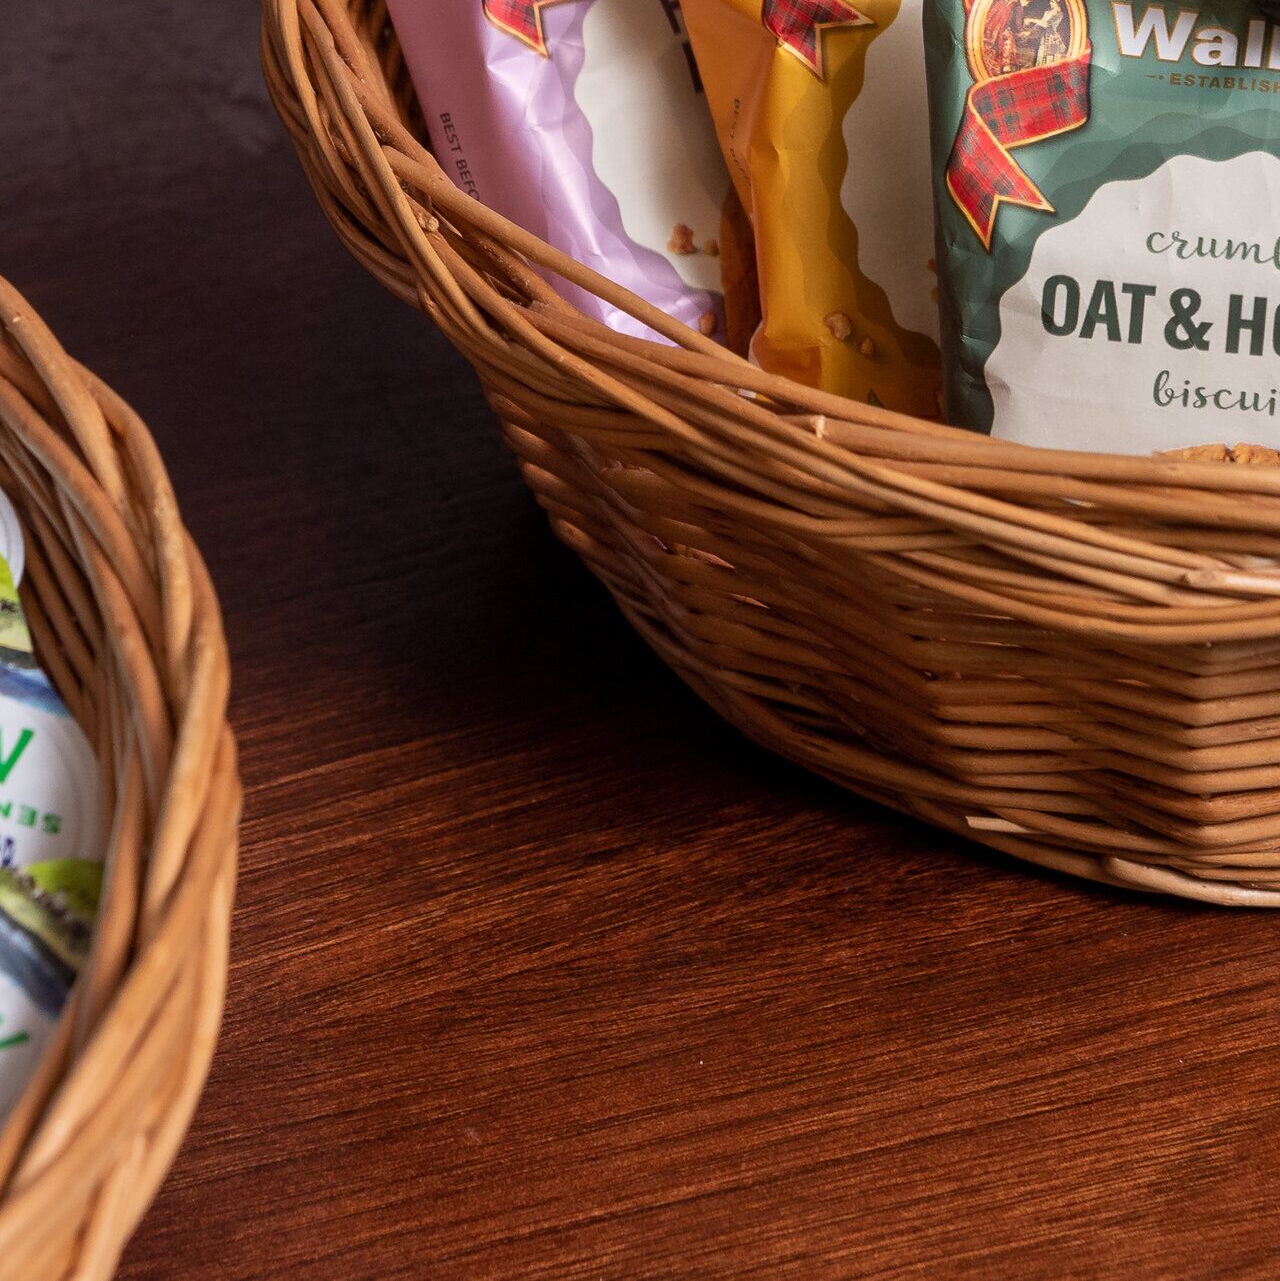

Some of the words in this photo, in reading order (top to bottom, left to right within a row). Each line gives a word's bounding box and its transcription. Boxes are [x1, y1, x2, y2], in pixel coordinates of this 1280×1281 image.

[439, 111, 463, 154] BEST
[455, 158, 481, 202] BEFO
[1040, 274, 1157, 344] OAT
[1163, 286, 1212, 352] &
